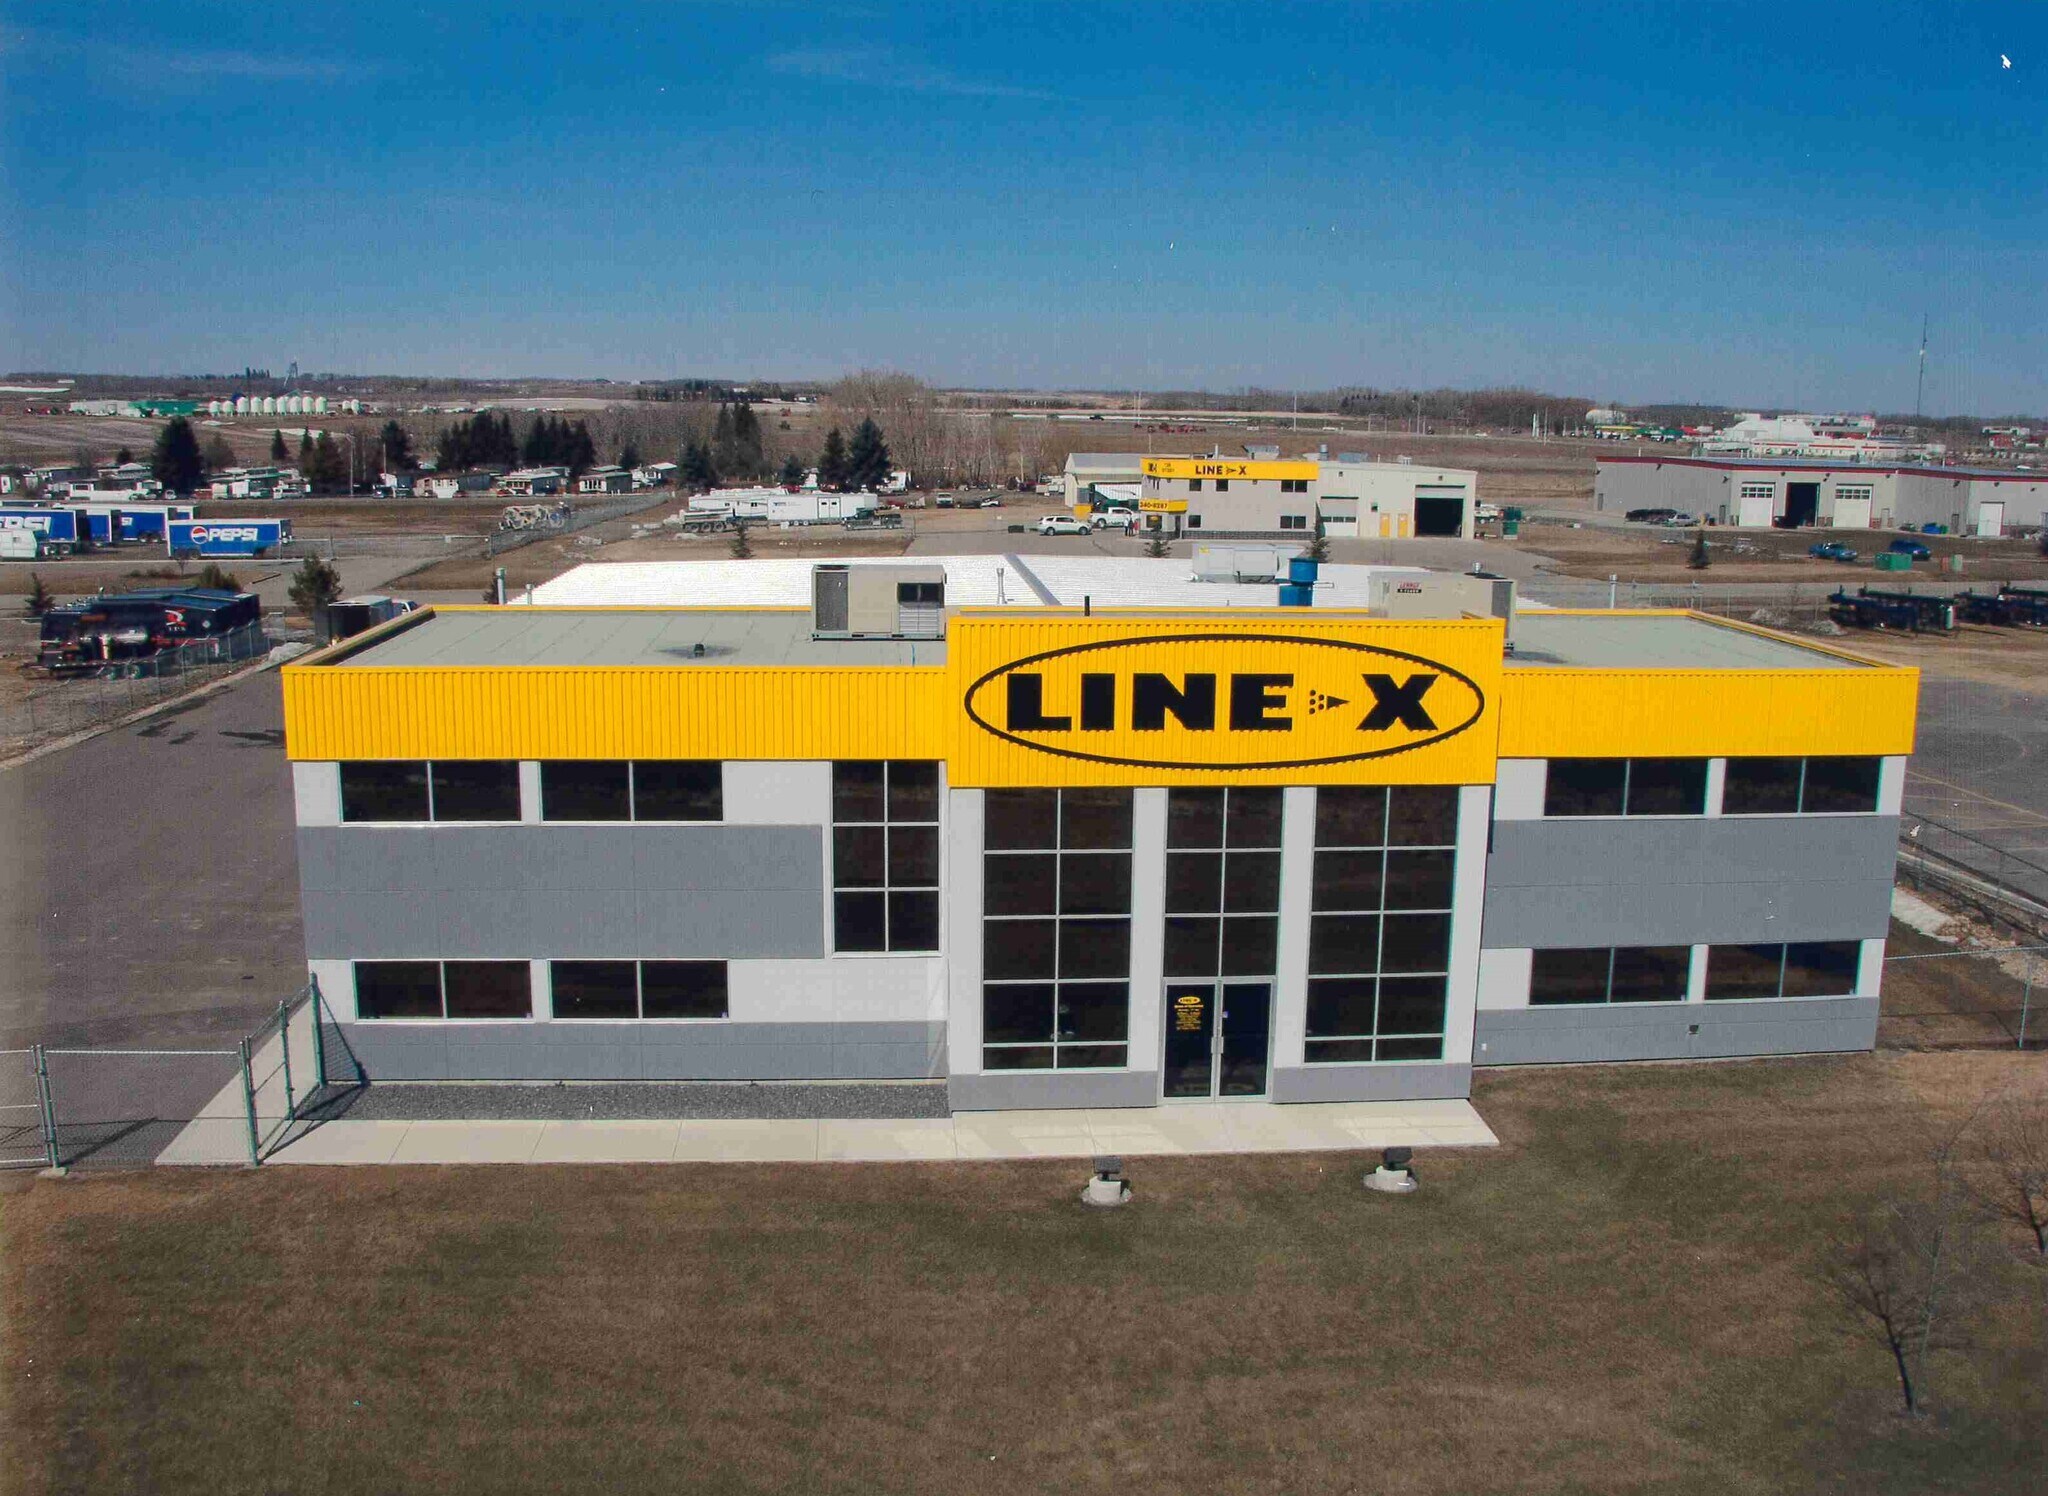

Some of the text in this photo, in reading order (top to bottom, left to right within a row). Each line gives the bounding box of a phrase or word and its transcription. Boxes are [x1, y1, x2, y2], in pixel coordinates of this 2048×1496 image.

[1195, 465, 1247, 475] LINE X
[208, 528, 258, 541] PEPSI
[1006, 673, 1440, 731] LINE X
